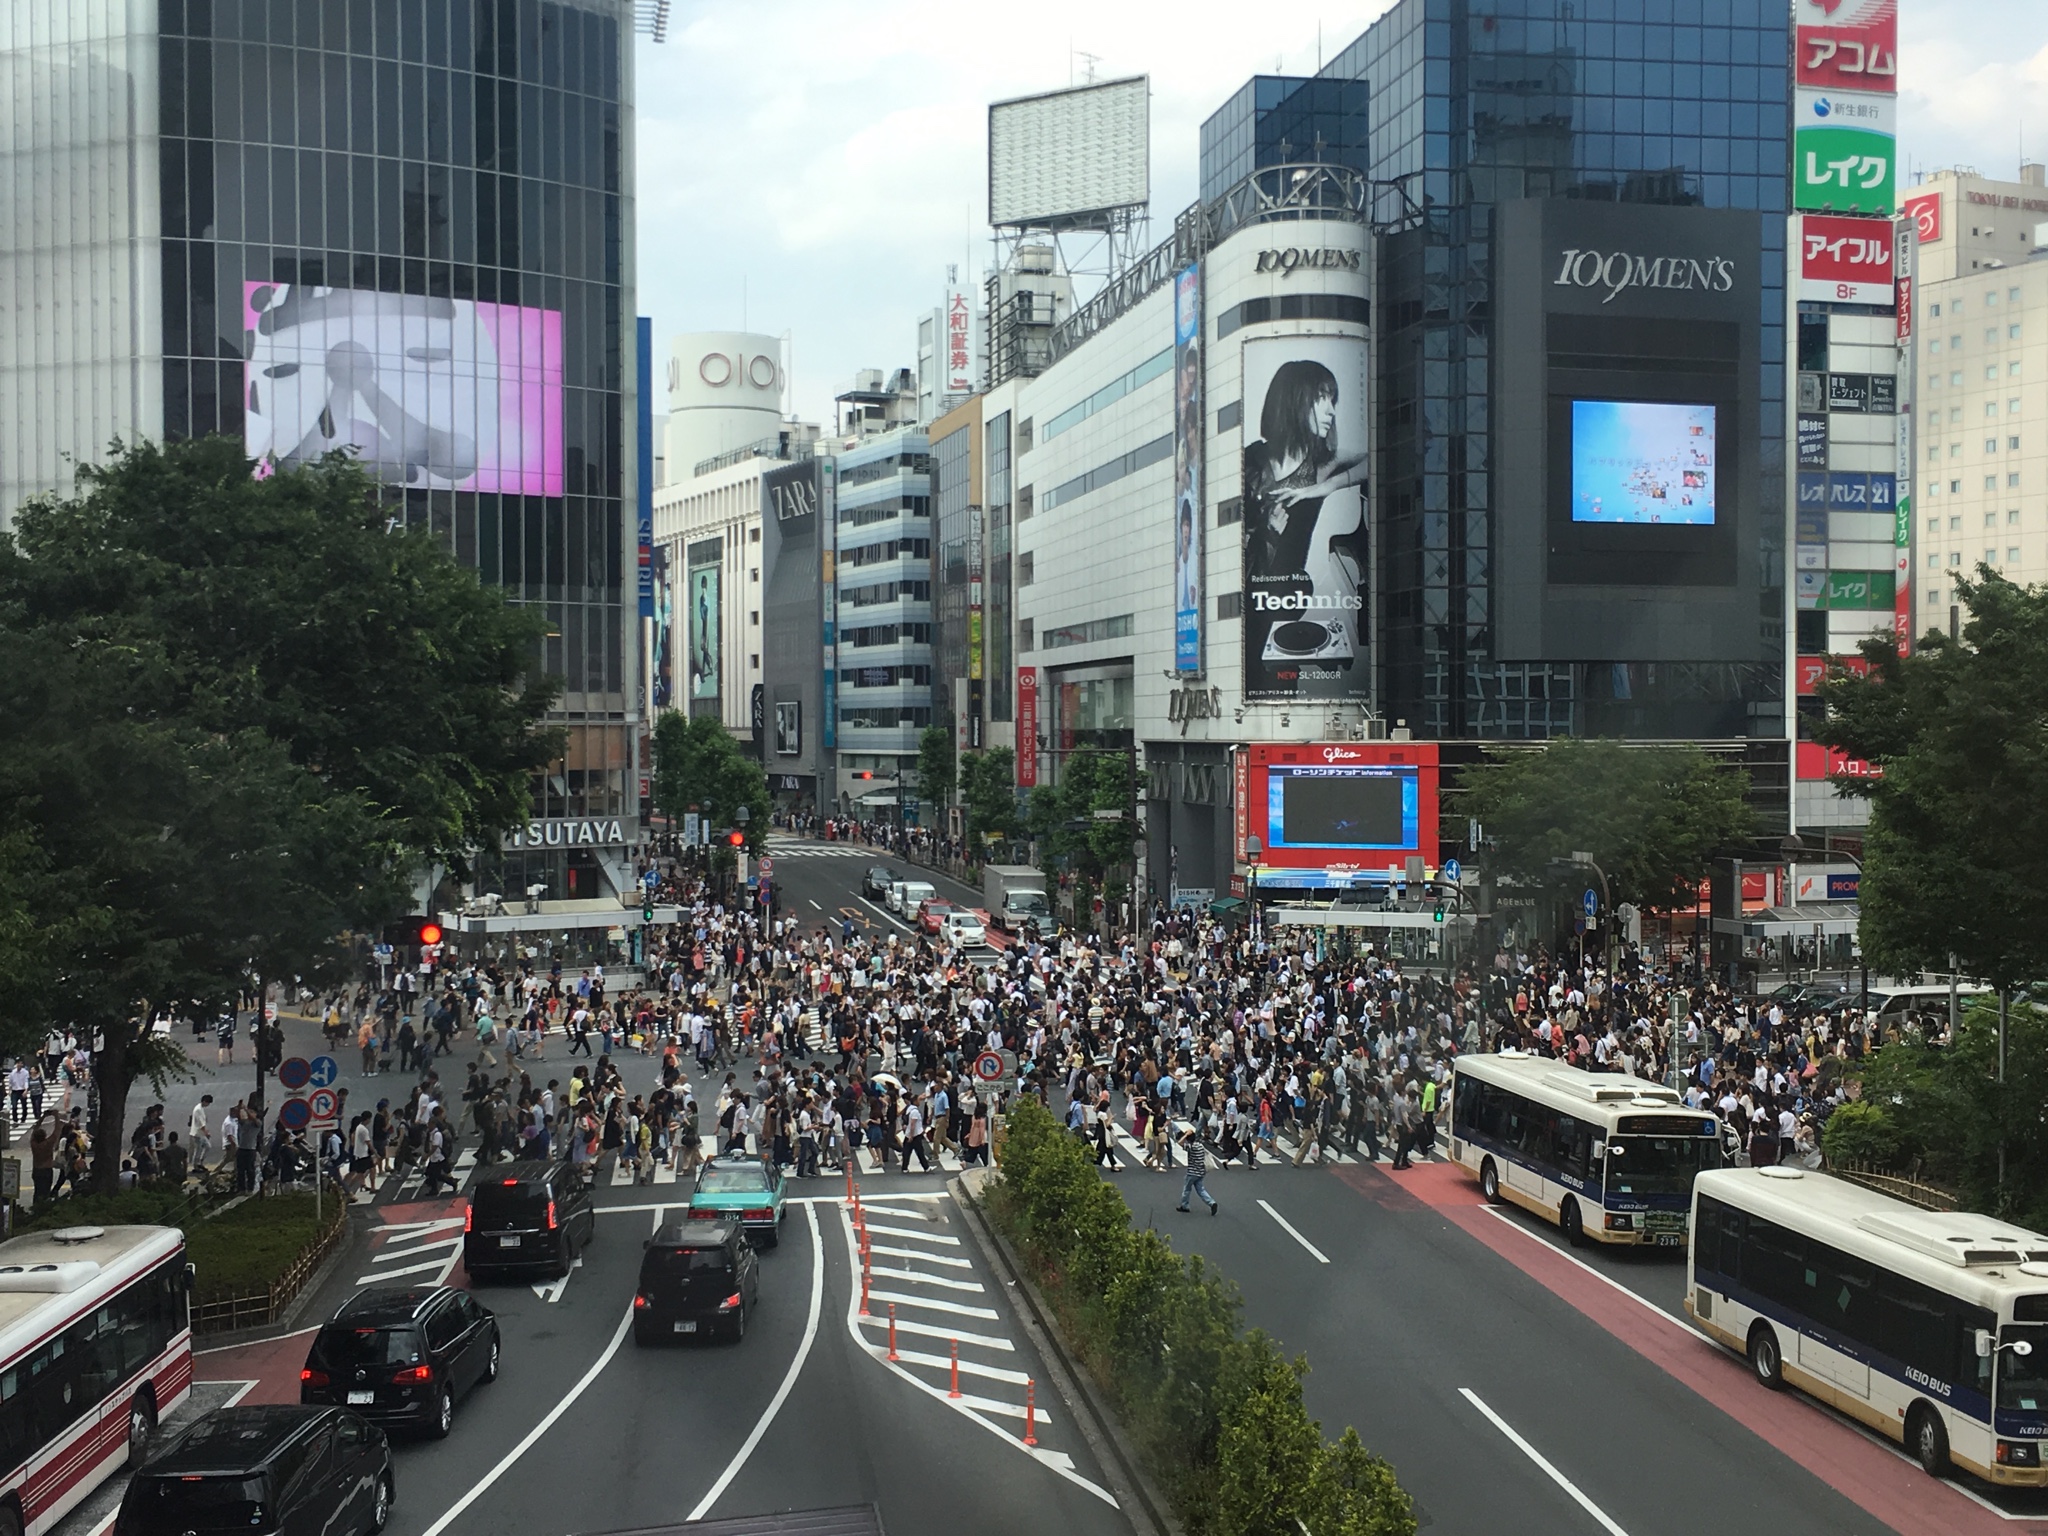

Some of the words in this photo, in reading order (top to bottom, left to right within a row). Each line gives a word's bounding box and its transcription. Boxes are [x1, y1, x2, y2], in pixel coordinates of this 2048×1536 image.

[1808, 38, 1896, 75] アコム
[1834, 102, 1879, 119] 新生銀行
[1806, 152, 1887, 189] レイク
[1805, 235, 1889, 265] アイフル
[1837, 284, 1857, 300] 8F
[1901, 293, 1909, 336] アイフル
[950, 293, 970, 371] 大和証券
[772, 480, 817, 520] ZARA
[1801, 481, 1889, 504] レオパレス21
[1899, 506, 1908, 542] レイク
[1251, 575, 1290, 583] Rediscover
[1829, 582, 1867, 598] レイク
[1252, 590, 1363, 611] Technics
[1277, 671, 1298, 680] NEW
[1299, 670, 1341, 680] SL-1200GR
[754, 691, 763, 728] ZARA
[1023, 701, 1032, 779] 三菱東京UFJ銀行
[1837, 761, 1859, 774] 入口
[780, 776, 800, 790] ZARA
[511, 819, 624, 847] TSUTAYA
[1905, 1366, 1929, 1386] KEIO
[1929, 1378, 1952, 1397] BUS
[2019, 1427, 2042, 1435] KEIO
